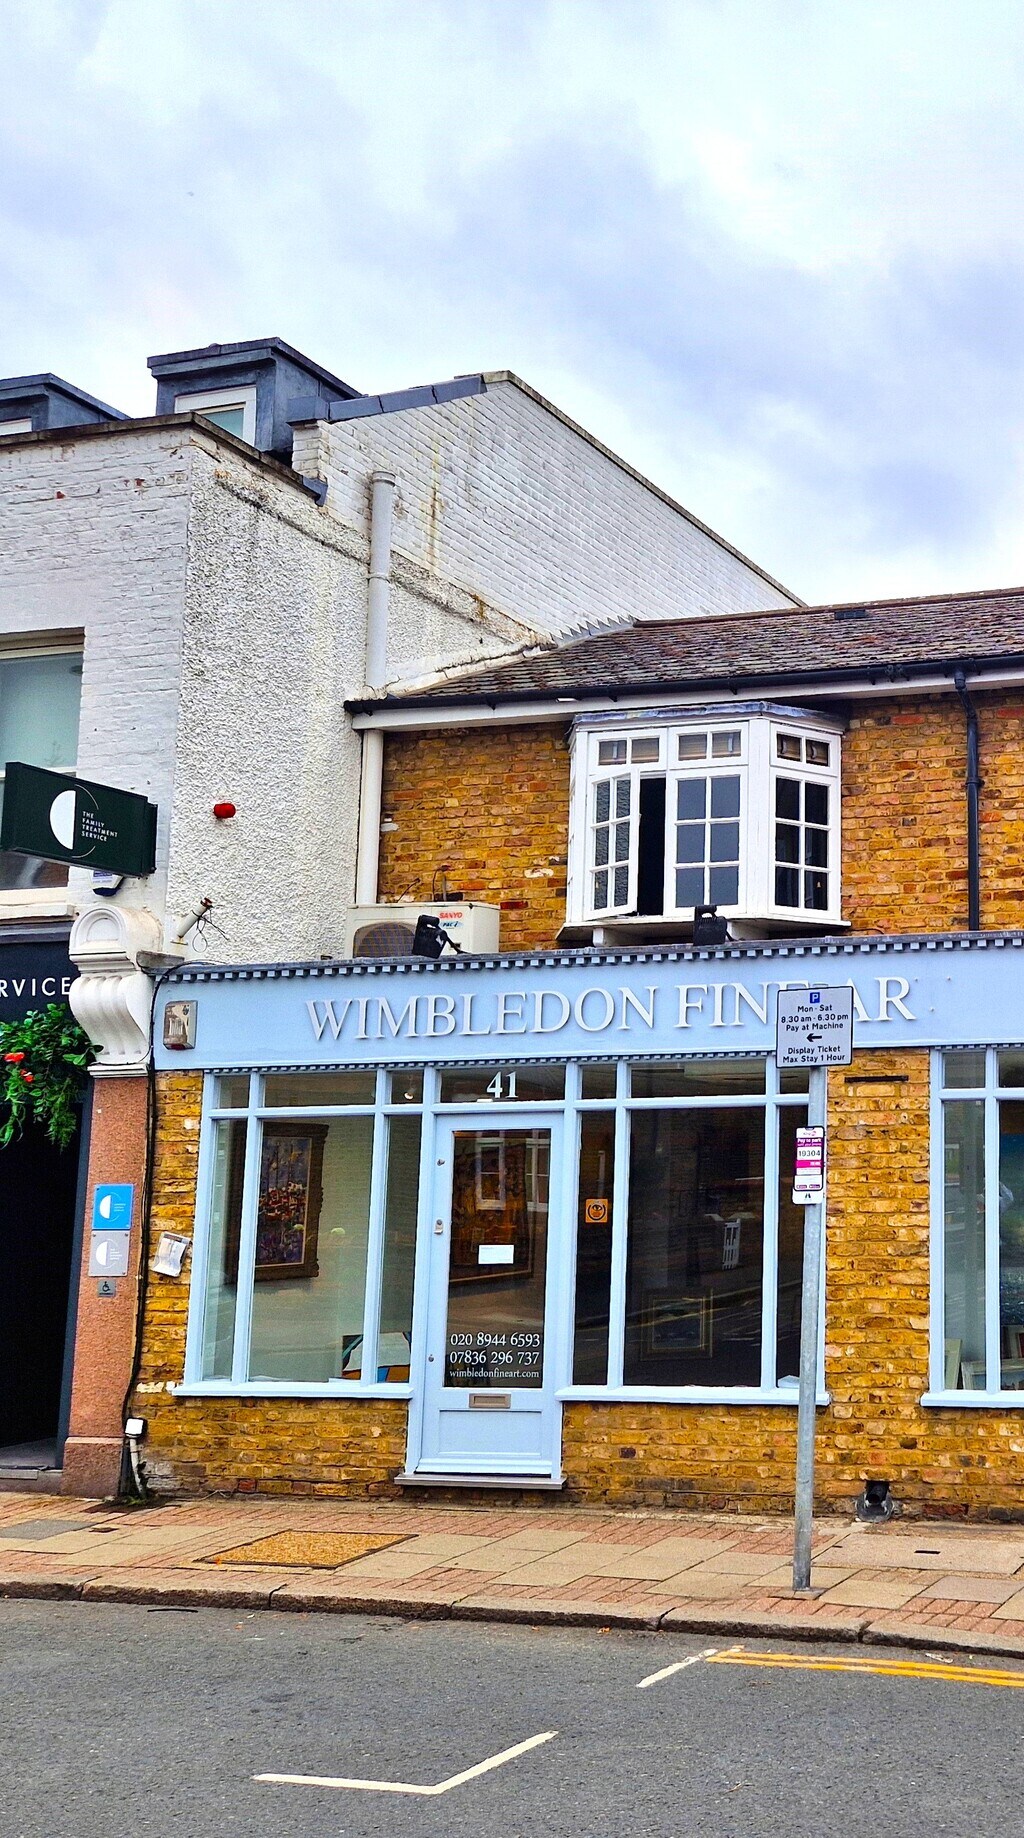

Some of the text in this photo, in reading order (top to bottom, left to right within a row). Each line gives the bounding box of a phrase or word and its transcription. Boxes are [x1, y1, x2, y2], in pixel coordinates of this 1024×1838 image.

[82, 810, 94, 819] THE
[82, 818, 105, 828] FAMILY
[82, 824, 118, 837] TREATMENT
[81, 831, 107, 841] SERVICE
[811, 993, 820, 1003] P
[305, 984, 657, 1041] WIMBLEDON
[674, 980, 809, 1029] FIN
[797, 1005, 814, 1013] Mon
[819, 1004, 833, 1012] Sat
[781, 1015, 799, 1024] 8.30
[817, 1013, 836, 1021] 6.30
[837, 1014, 849, 1022] pm
[786, 1022, 844, 1032] Pay at Machine
[788, 1045, 841, 1055] Display Ticket
[801, 1055, 818, 1063] Stay
[820, 1054, 824, 1062] 1
[486, 1071, 519, 1099] 41
[450, 1332, 541, 1347] 020 8944 6593
[449, 1349, 540, 1366] 07836 296 737
[449, 1367, 540, 1378] wimbledonfineart.com
